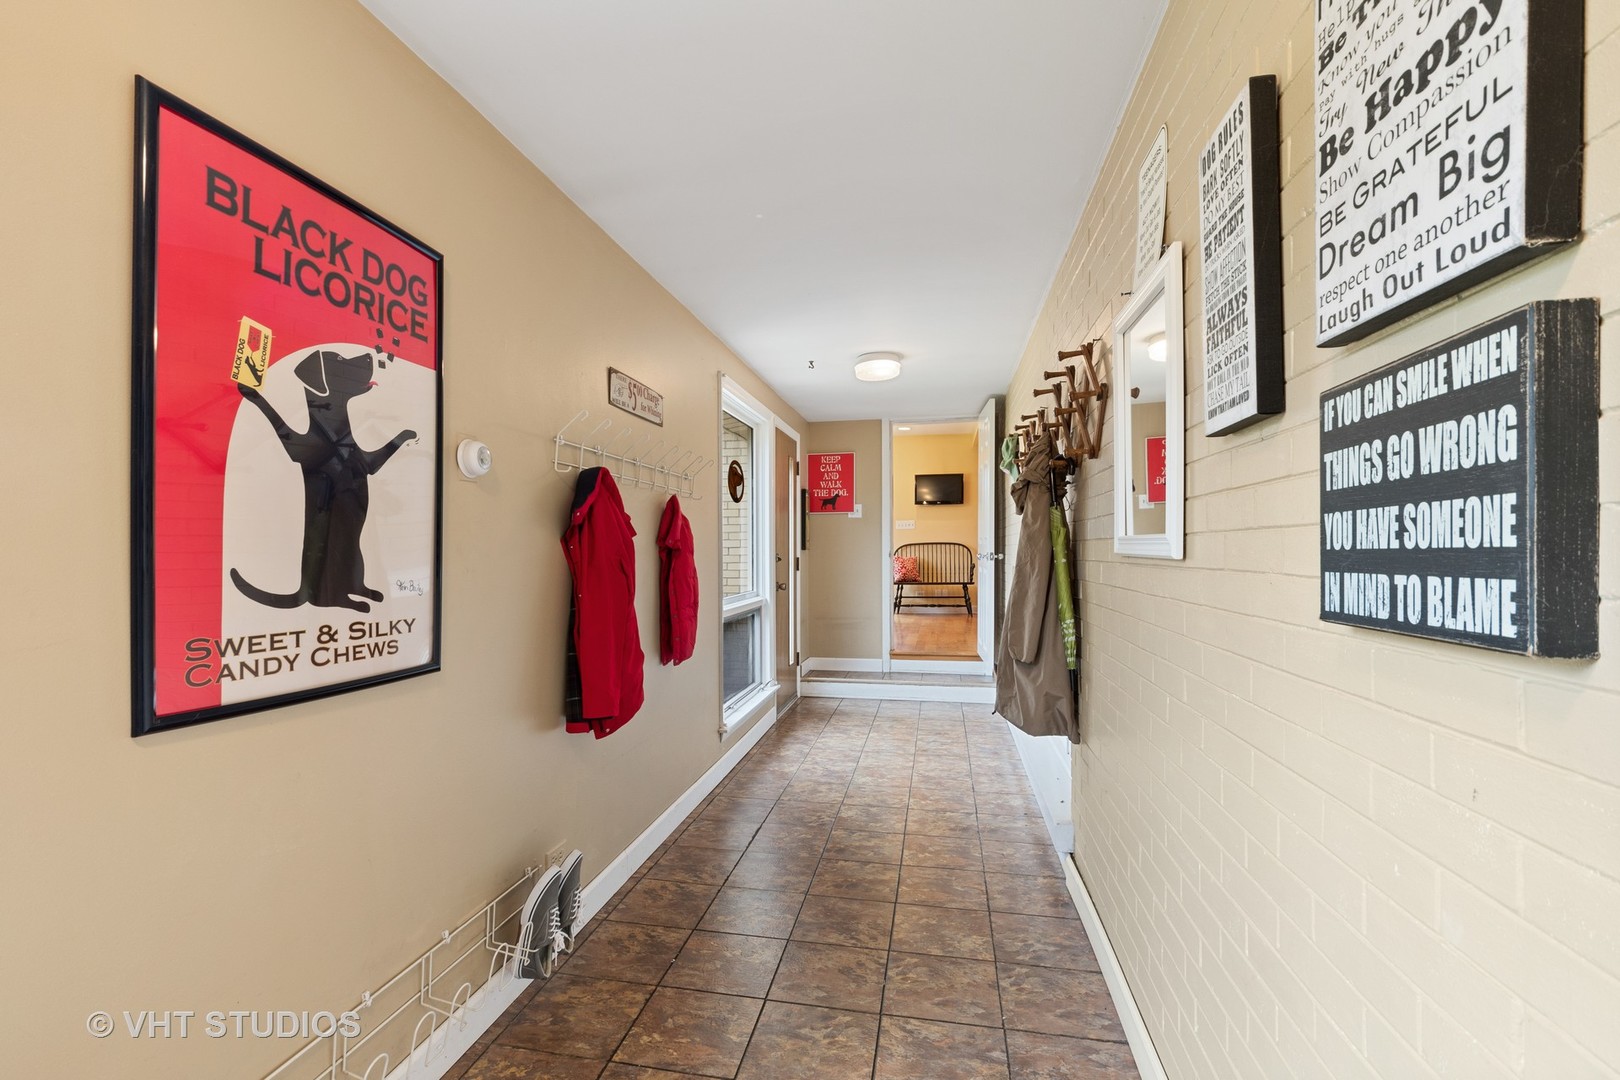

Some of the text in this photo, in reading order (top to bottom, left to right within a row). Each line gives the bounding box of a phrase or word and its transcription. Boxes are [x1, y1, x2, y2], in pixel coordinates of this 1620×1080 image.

[1318, 31, 1347, 75] Be
[1319, 90, 1336, 111] pay
[1341, 55, 1367, 86] with
[1375, 13, 1404, 50] hugs
[1319, 41, 1360, 95] Know
[1319, 0, 1502, 177] Be Happy
[1319, 102, 1348, 137] Try
[1356, 42, 1404, 94] New
[1202, 101, 1243, 177] DOG RULES
[1319, 26, 1512, 204] Show Compassion
[1203, 155, 1243, 214] LOVE OFTEN
[1320, 77, 1513, 238] BE GRATEFUL
[205, 165, 428, 307] BLACK DOG
[1319, 124, 1511, 280] Dream Big
[1319, 180, 1510, 307] respect one another
[1319, 206, 1511, 334] Laugh Out Loud
[254, 235, 428, 343] LICORICE
[1206, 285, 1247, 336] ALWAYS
[232, 338, 246, 380] BLACK DOG
[260, 333, 269, 367] LICORICE
[1206, 308, 1248, 355] FAITHFUL
[1207, 341, 1248, 379] LICK OFTEN
[1324, 325, 1518, 432] IF YOU CAN SMILE WHEN
[1324, 404, 1518, 491] THINGS GO WRONG
[1324, 493, 1517, 550] YOU HAVE SOMEONE
[185, 618, 416, 662] SWEET & SILKY
[1324, 571, 1517, 639] IN MIND TO BLAME
[184, 640, 399, 688] CANDY CHEWS
